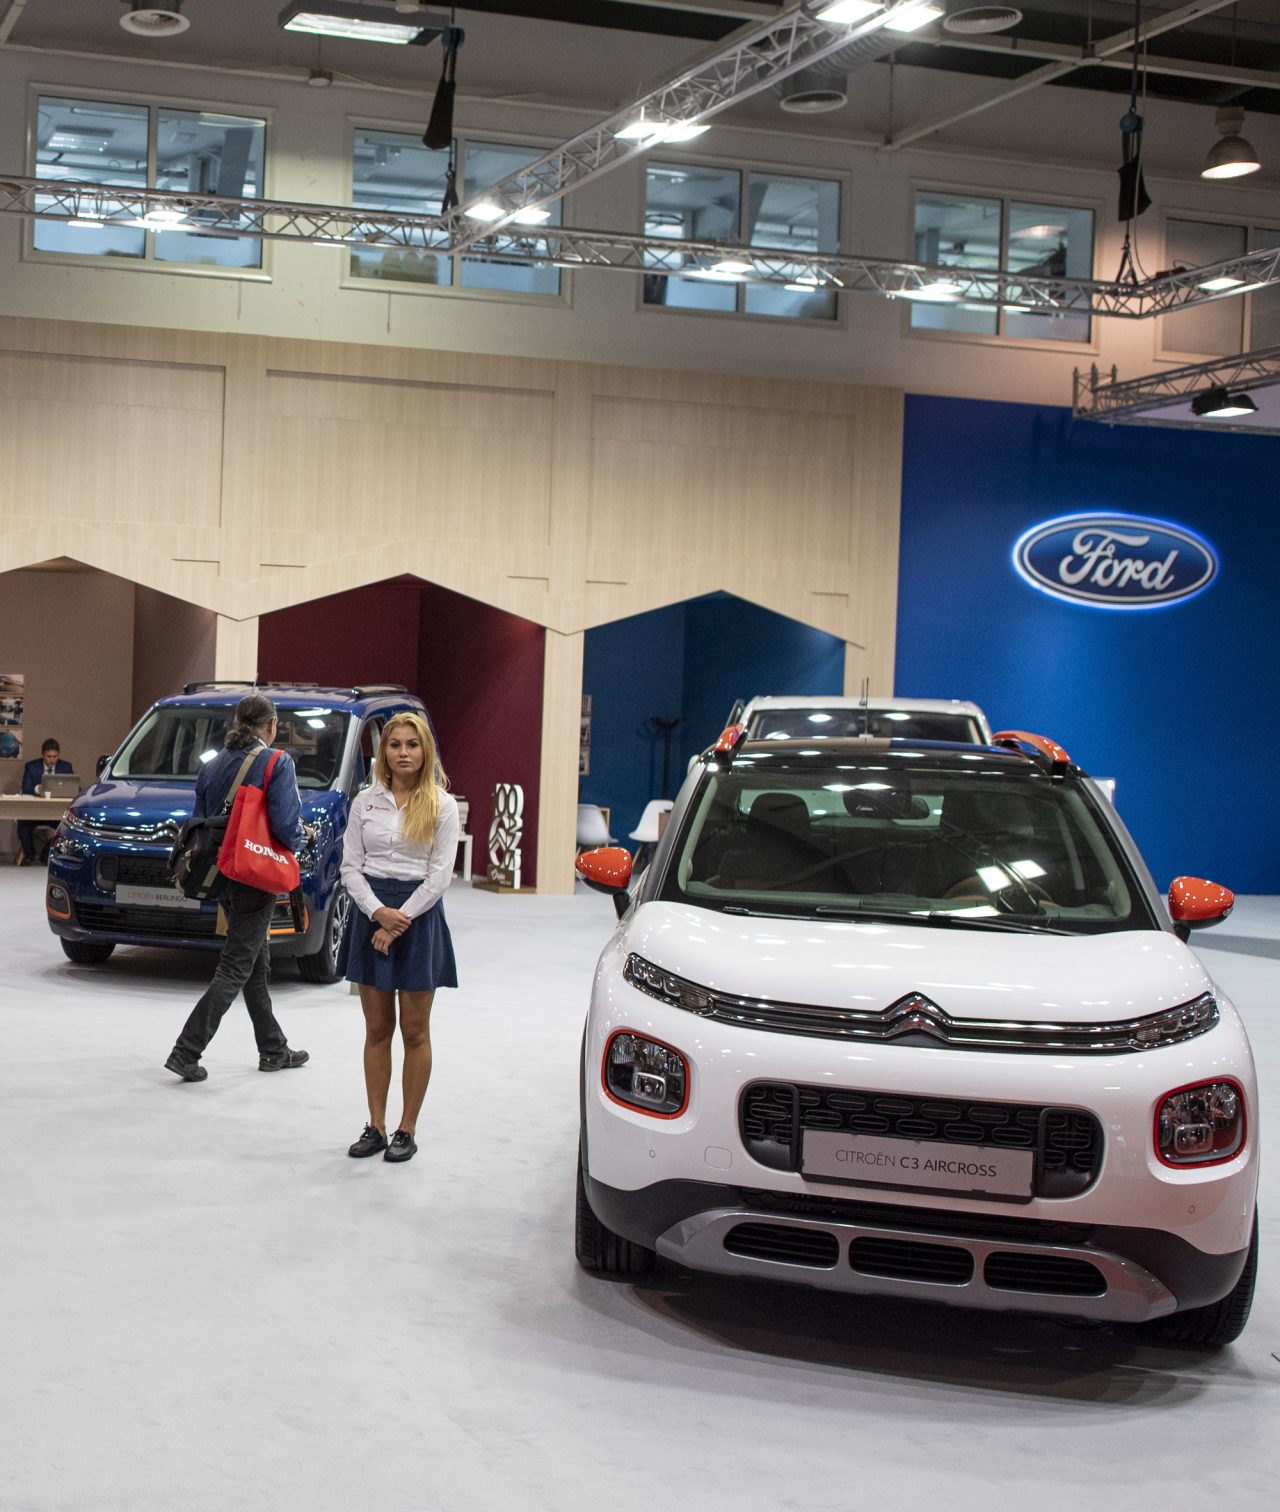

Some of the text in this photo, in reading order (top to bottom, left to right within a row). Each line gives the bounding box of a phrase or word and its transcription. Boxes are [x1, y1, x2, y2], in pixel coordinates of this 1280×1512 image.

[1058, 528, 1176, 591] Ford
[243, 838, 290, 865] HONDA
[835, 1150, 997, 1178] CITROËN C3 AIRCROSS
